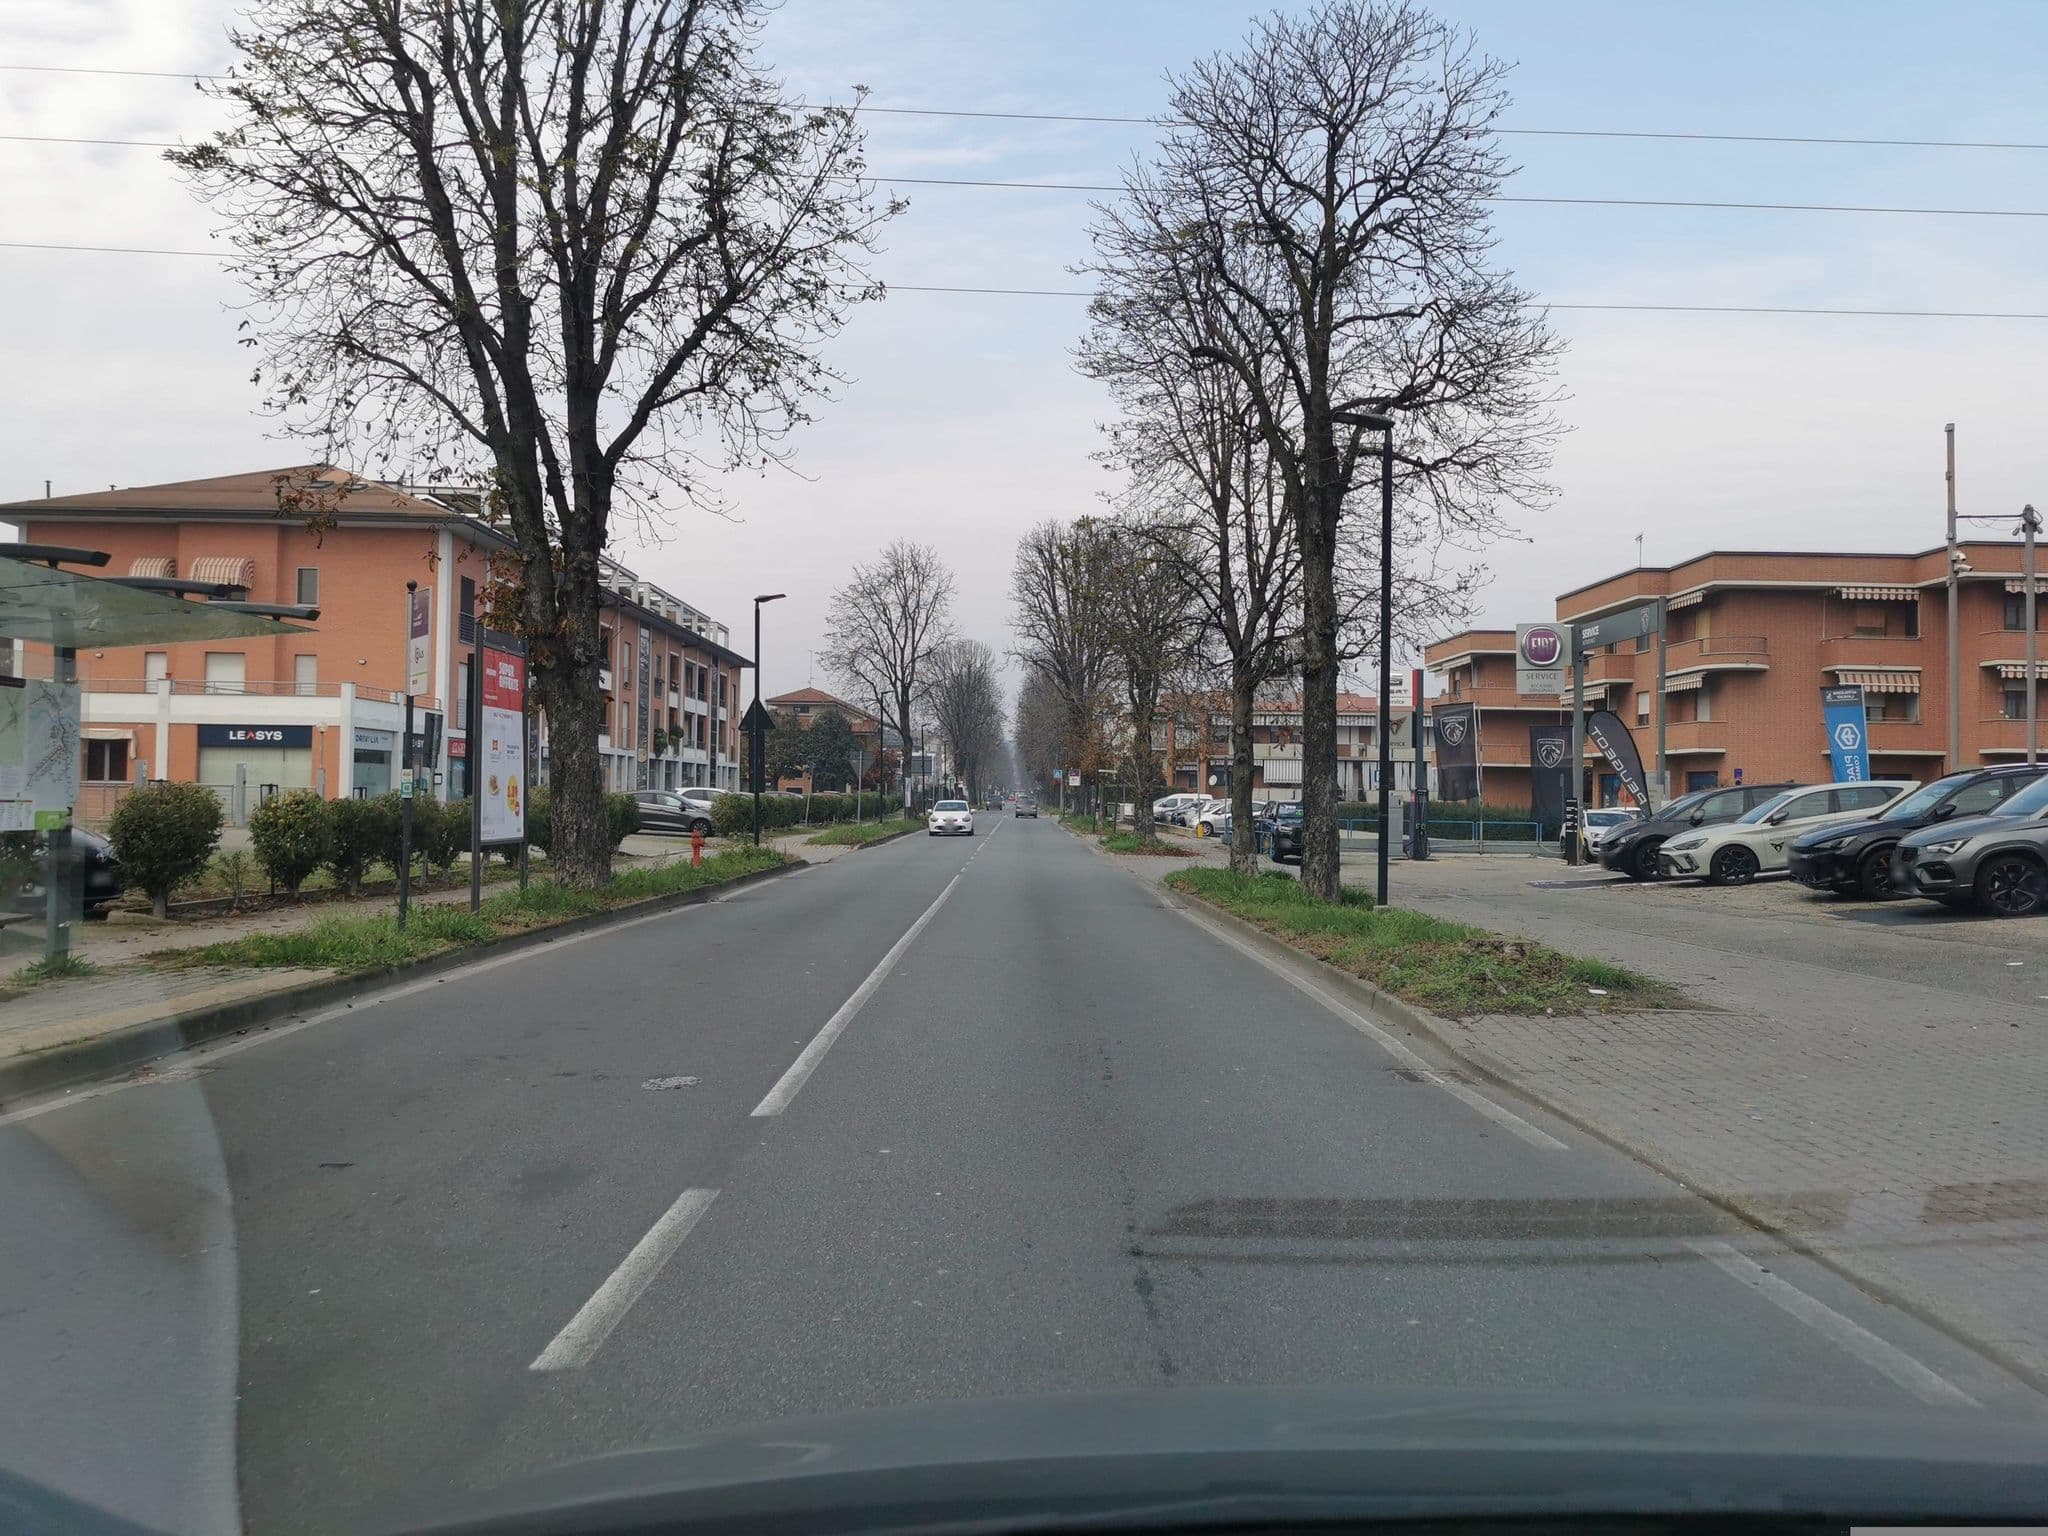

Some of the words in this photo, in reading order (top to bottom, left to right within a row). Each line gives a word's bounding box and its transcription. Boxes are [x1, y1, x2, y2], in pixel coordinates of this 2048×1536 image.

[1582, 625, 1600, 639] SERVICE
[1531, 637, 1555, 653] FIAT
[1526, 672, 1557, 680] SERVICE
[229, 730, 283, 741] LEASYS
